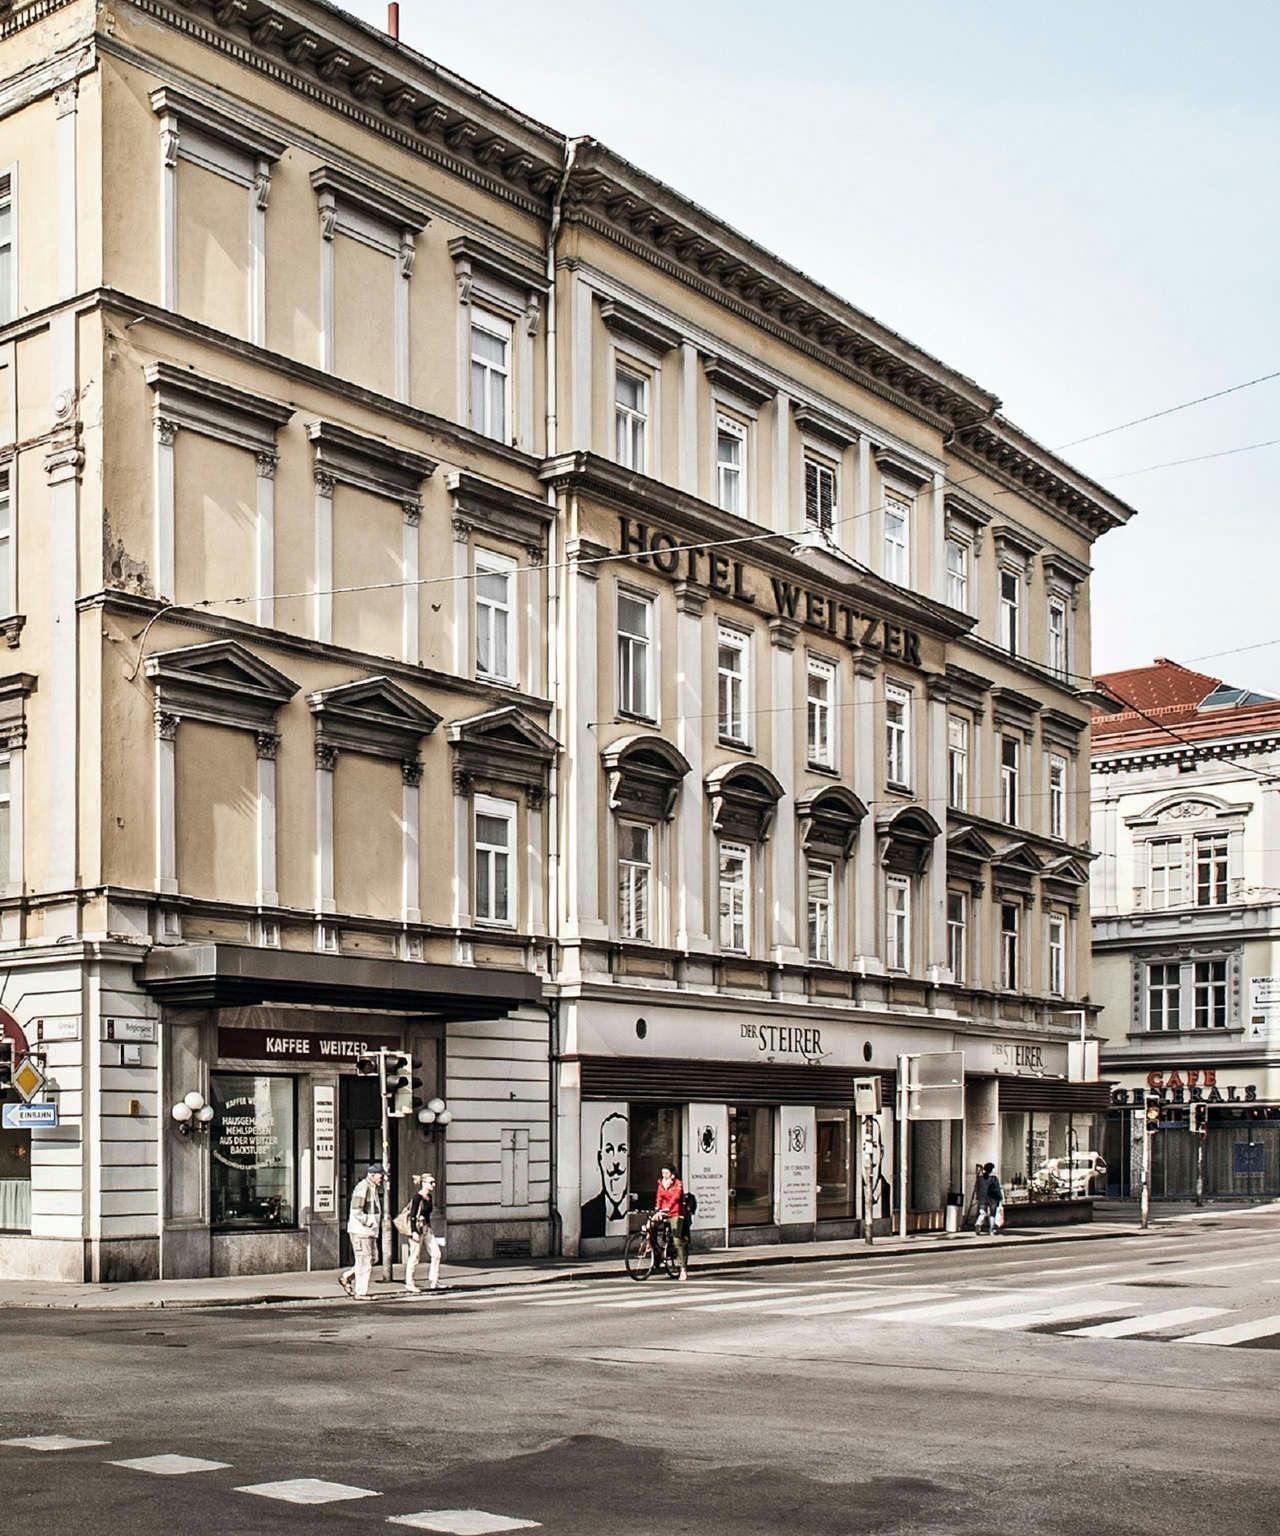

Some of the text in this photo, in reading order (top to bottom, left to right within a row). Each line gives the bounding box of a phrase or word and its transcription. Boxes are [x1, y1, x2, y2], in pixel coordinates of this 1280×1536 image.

[618, 516, 923, 666] HOTEL WEITZER
[266, 1037, 368, 1056] KAFFEE WEITZER
[740, 1023, 827, 1058] DER STEIRER
[1147, 1070, 1217, 1088] CAFE
[1111, 1085, 1257, 1105] GENERALS
[20, 1111, 52, 1119] EINBAHN
[219, 1136, 233, 1145] AUS
[234, 1136, 248, 1145] DER
